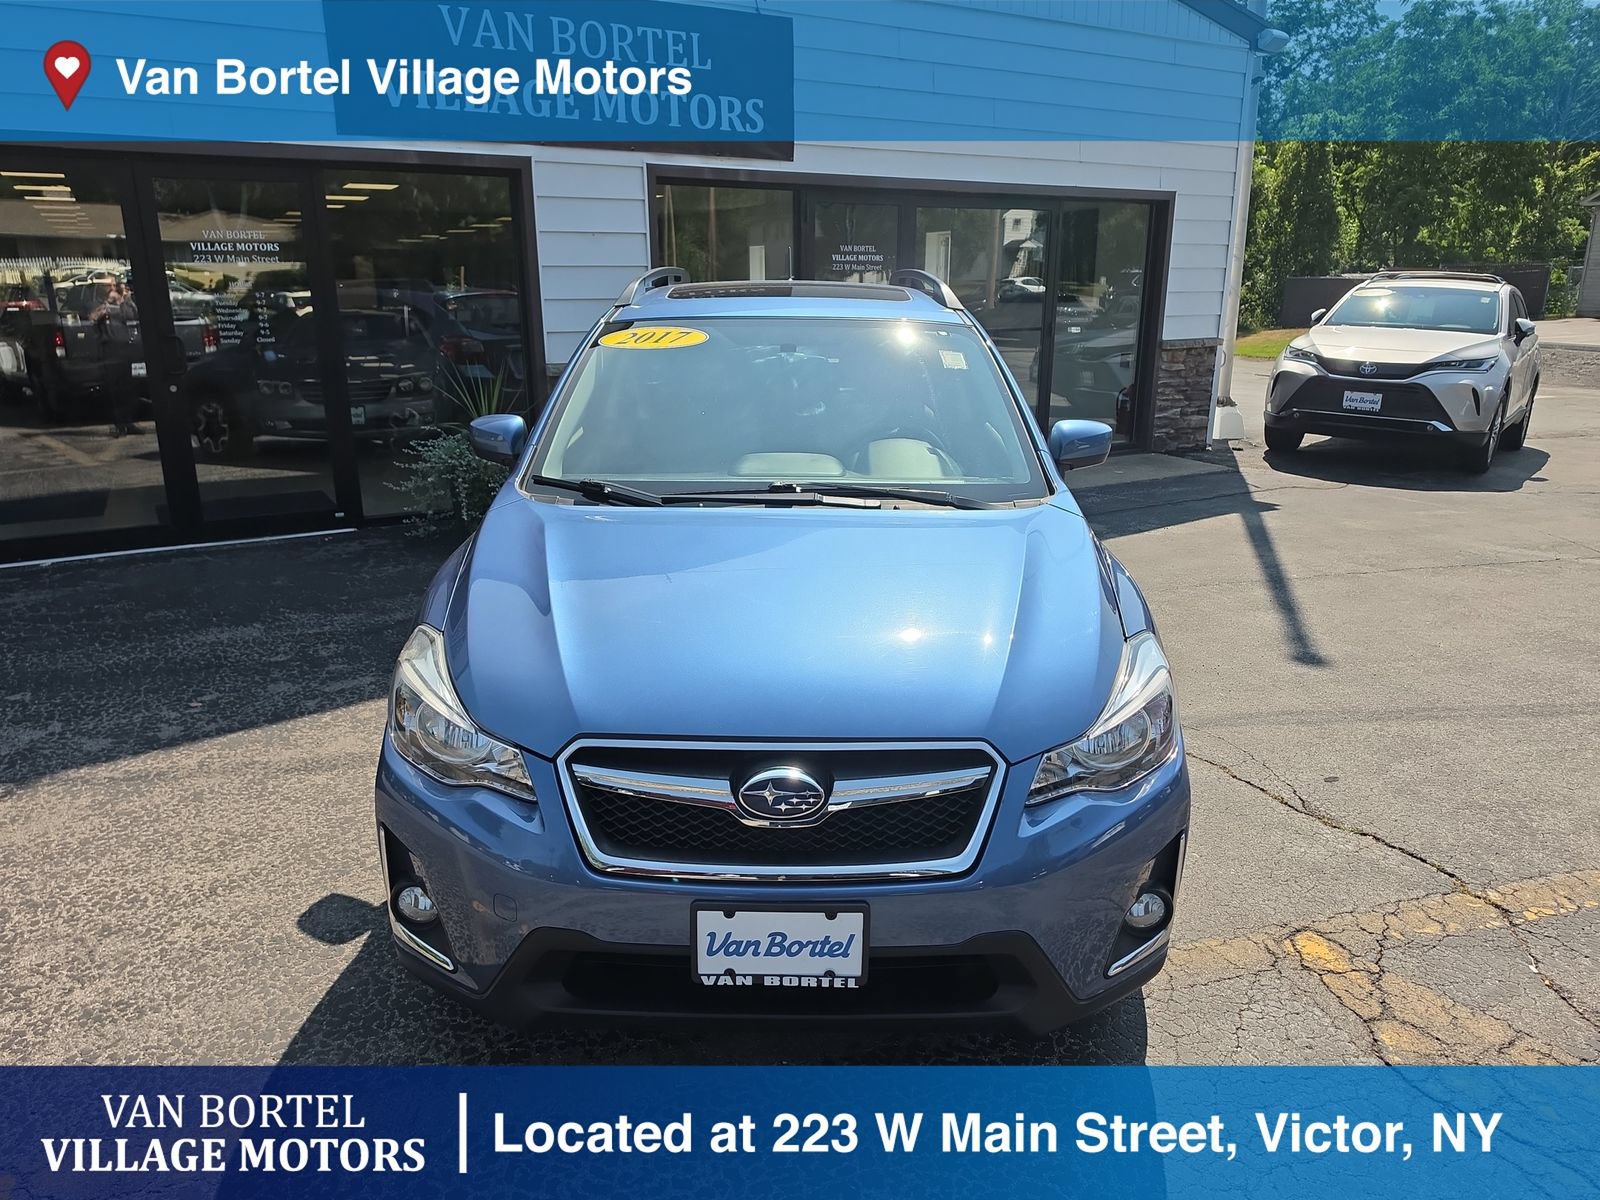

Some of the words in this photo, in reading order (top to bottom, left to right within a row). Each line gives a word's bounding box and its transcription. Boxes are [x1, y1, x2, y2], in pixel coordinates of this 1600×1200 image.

[437, 4, 535, 53] VAN
[549, 16, 713, 71] BORTEL
[593, 82, 765, 134] MOTORS
[202, 230, 223, 239] VAN
[226, 231, 266, 240] BORTEL
[190, 242, 234, 251] VILLAGE
[236, 243, 280, 252] MOTORS
[193, 254, 212, 264] 223
[214, 254, 225, 263] W
[226, 254, 250, 264] Main
[251, 254, 280, 264] Street
[615, 331, 693, 345] 2017
[705, 931, 762, 958] Van
[762, 931, 856, 959] Bortel
[700, 975, 753, 986] VAN
[763, 975, 860, 989] BORTEL
